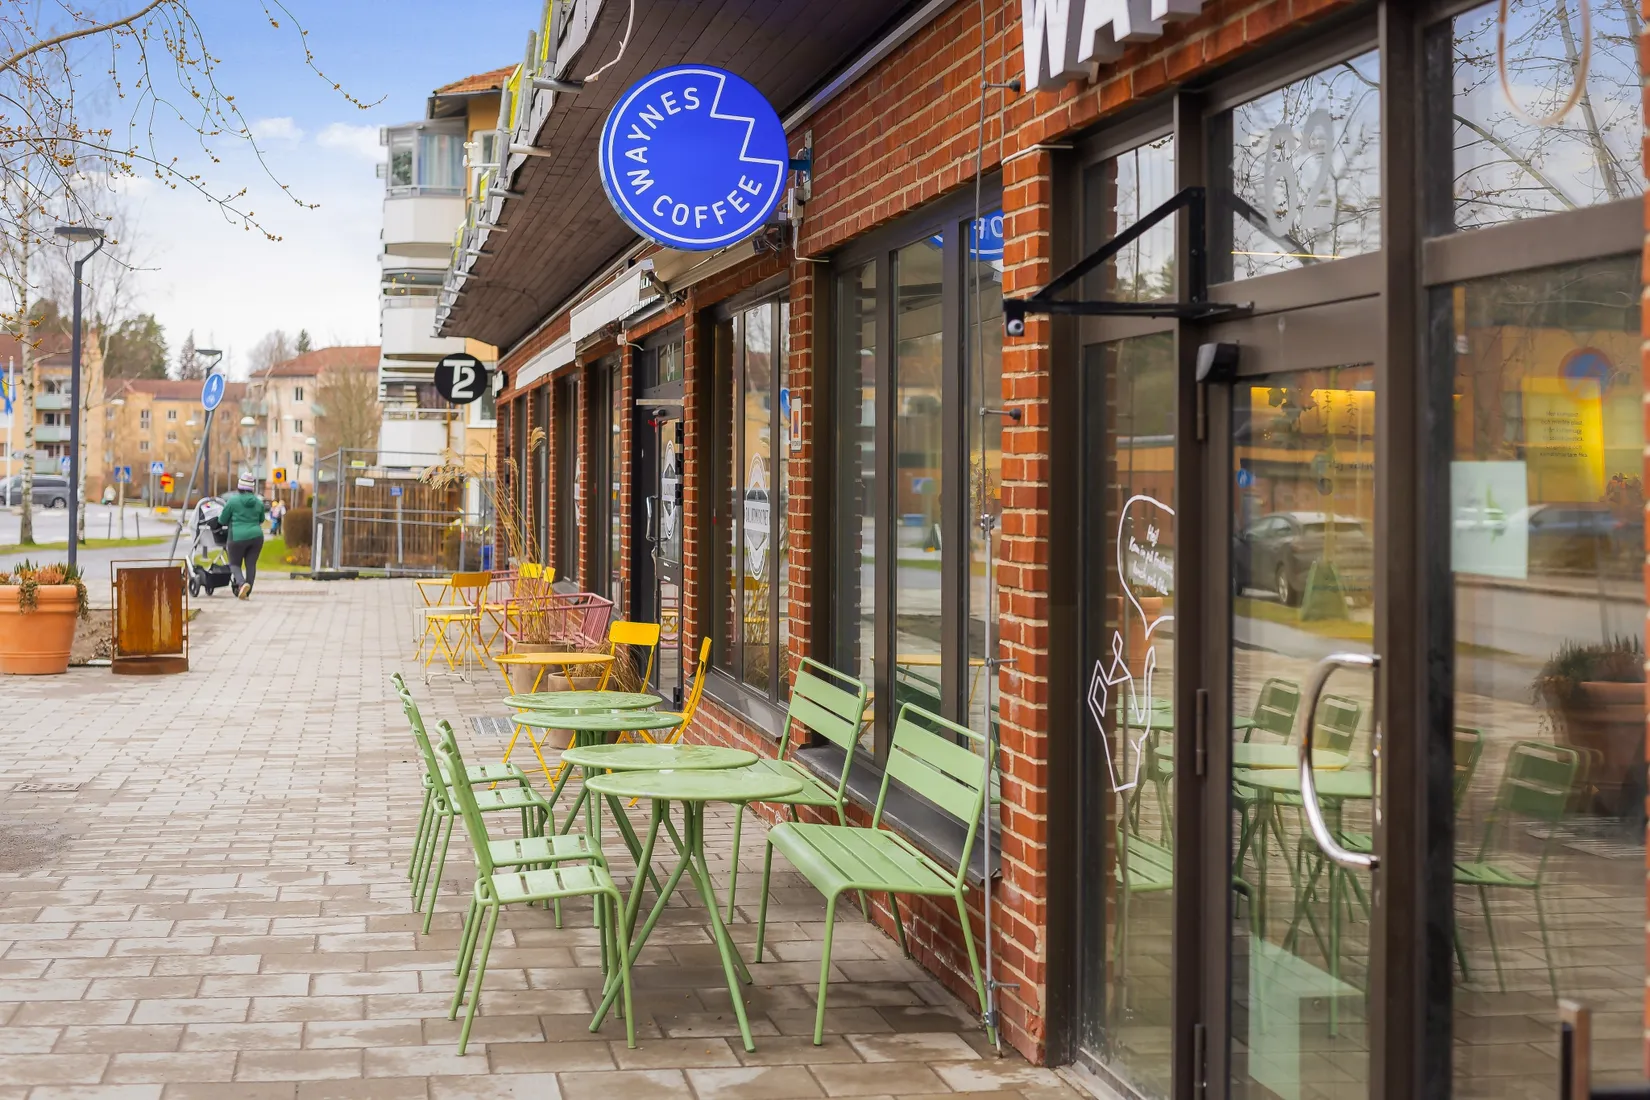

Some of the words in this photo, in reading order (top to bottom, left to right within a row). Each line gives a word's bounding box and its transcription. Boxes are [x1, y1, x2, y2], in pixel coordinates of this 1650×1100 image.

[625, 87, 700, 195] WAYNES
[1264, 109, 1335, 238] 62
[653, 175, 763, 229] COFFEE
[443, 359, 476, 398] T2
